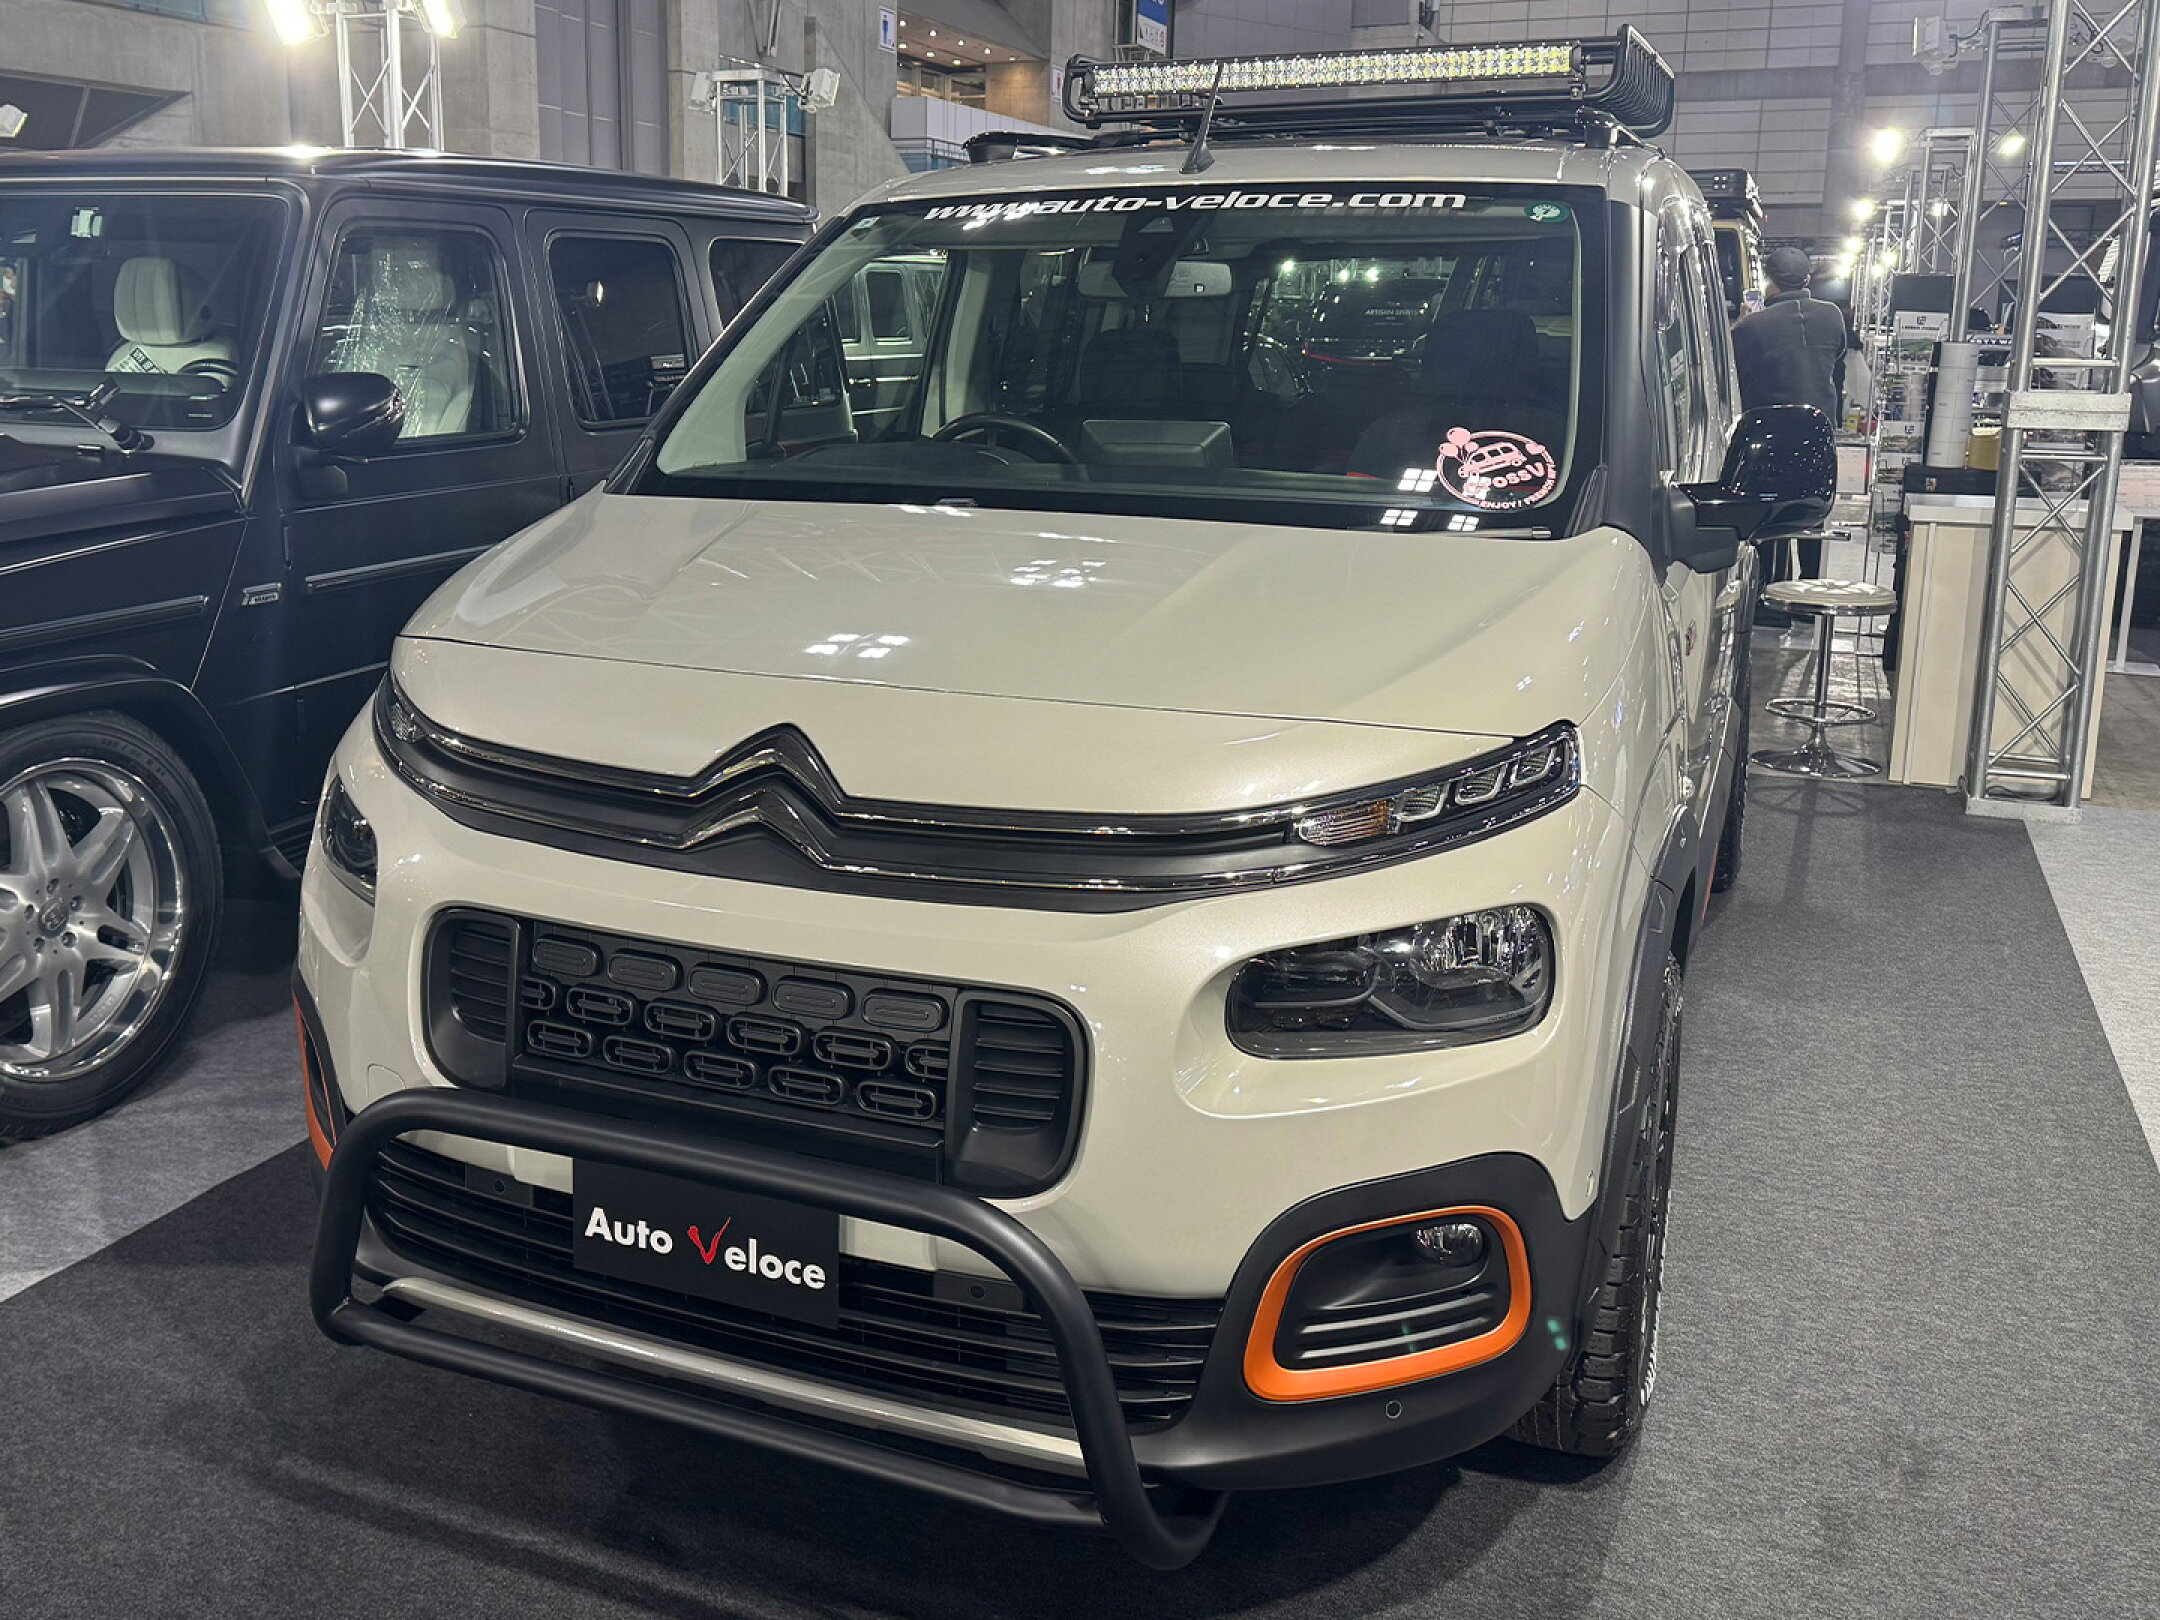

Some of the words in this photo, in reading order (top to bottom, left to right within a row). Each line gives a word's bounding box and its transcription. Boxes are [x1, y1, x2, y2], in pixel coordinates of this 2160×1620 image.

[924, 190, 1466, 221] www.auto-veloce.com
[584, 1206, 674, 1255] Auto
[687, 1216, 827, 1290] Veloce
